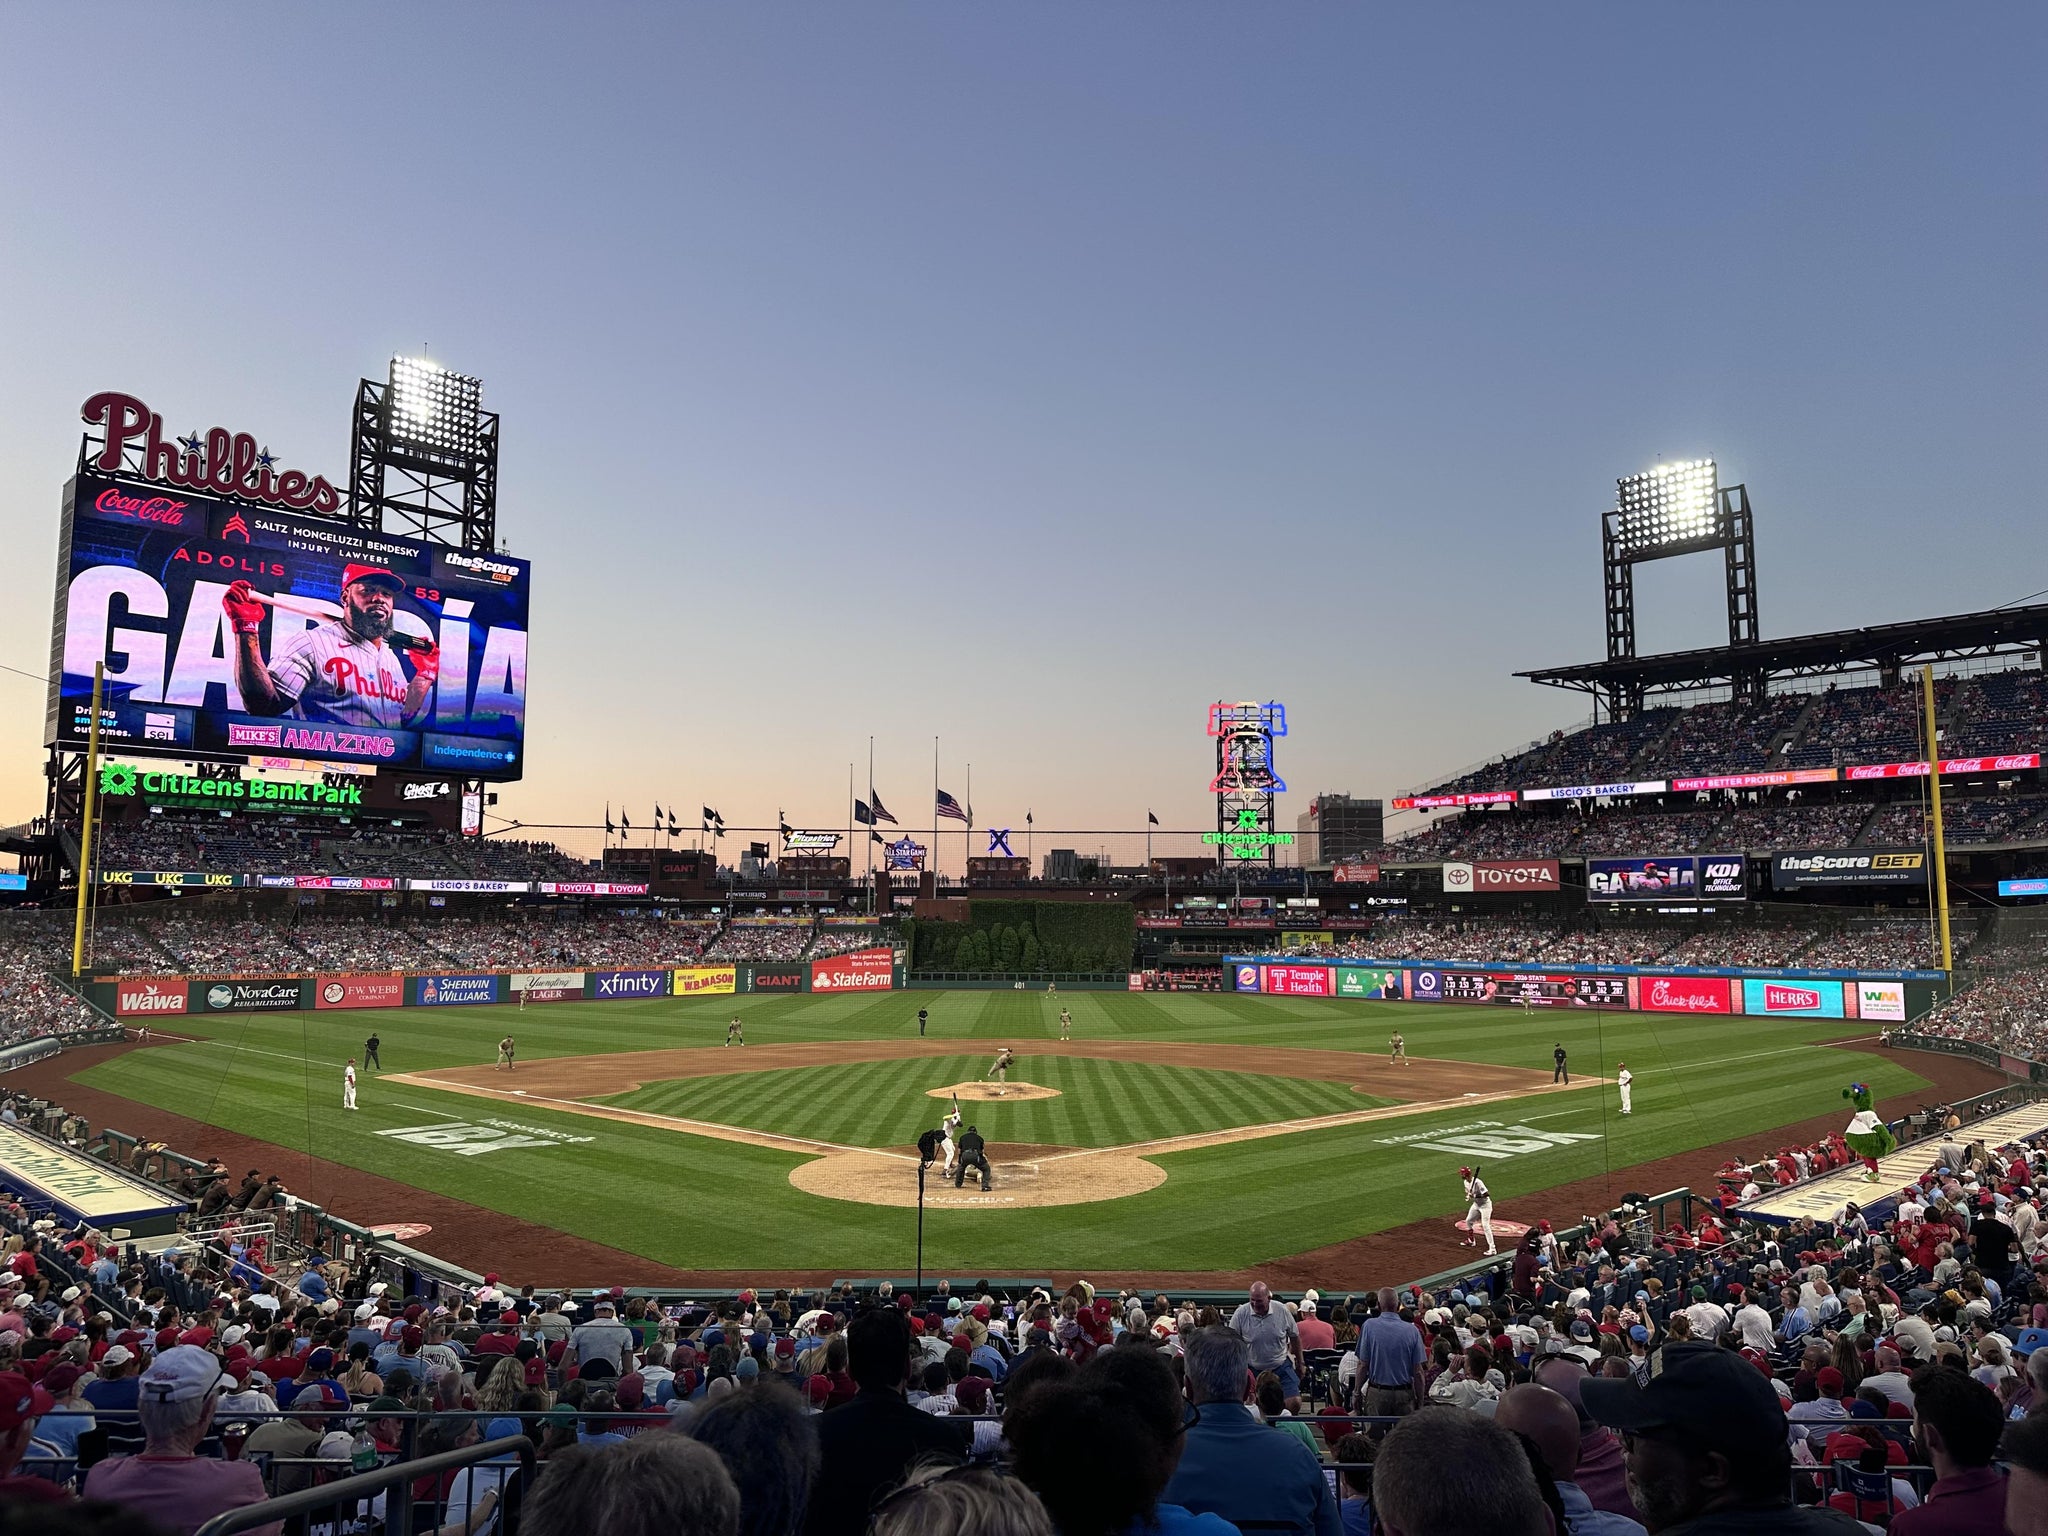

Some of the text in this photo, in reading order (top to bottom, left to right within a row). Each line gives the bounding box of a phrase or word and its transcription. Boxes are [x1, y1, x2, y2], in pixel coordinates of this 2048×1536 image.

[82, 392, 340, 514] Phillies
[95, 489, 190, 526] Coca-Cola
[254, 520, 420, 558] SALTZ MONGELUZZI BENDESKY
[288, 540, 390, 565] INJURY LAWYERS
[174, 548, 286, 577] ADOLIS
[445, 552, 520, 577] theScore
[415, 588, 440, 601] 53
[324, 657, 408, 701] Phillie
[75, 705, 116, 719] Driing
[74, 716, 119, 727] smrter
[73, 726, 132, 738] outomes.
[234, 728, 395, 757] MIKE'S AMAZING
[434, 744, 504, 761] Independence
[1945, 760, 1981, 772] Coca-Cola
[1995, 756, 2032, 769] Coca-Cola
[1852, 766, 1887, 778] Coca-Cola
[1677, 773, 1787, 789] WHEY BETTER PROTEIN
[143, 771, 362, 805] Citizens Bank Park
[1550, 784, 1636, 798] LISCIO'S BAKERY
[1469, 795, 1488, 804] Deals
[1489, 794, 1500, 803] roll
[1202, 833, 1295, 845] Citizens Bank
[1233, 847, 1263, 859] Park
[662, 864, 695, 873] GIANT
[1780, 855, 1919, 871] theScore BET
[103, 872, 133, 884] UKG
[155, 873, 183, 885] UKG
[205, 874, 233, 886] UKG
[1477, 867, 1553, 884] TOYOTA
[365, 879, 393, 888] NECA
[432, 881, 509, 891] LISCIO'S BAKERY
[558, 883, 593, 892] TOYOTA
[611, 884, 645, 894] TOYOTA
[526, 975, 571, 988] Yuengling
[756, 975, 801, 985] GIANT
[1290, 970, 1325, 982] Temple
[367, 985, 398, 995] WEBB
[440, 978, 490, 990] SHERWIN
[600, 972, 660, 995] xfinity
[1290, 981, 1323, 993] Health
[234, 985, 299, 998] NovaCare
[532, 990, 563, 999] LAGER
[1651, 981, 1719, 1008] Chick-fil-A
[1770, 990, 1813, 1006] HERR'S
[1864, 991, 1900, 1002] WM
[122, 993, 184, 1011] Wawa
[234, 1000, 295, 1008] REHABILITATION
[53, 1174, 127, 1197] Park
